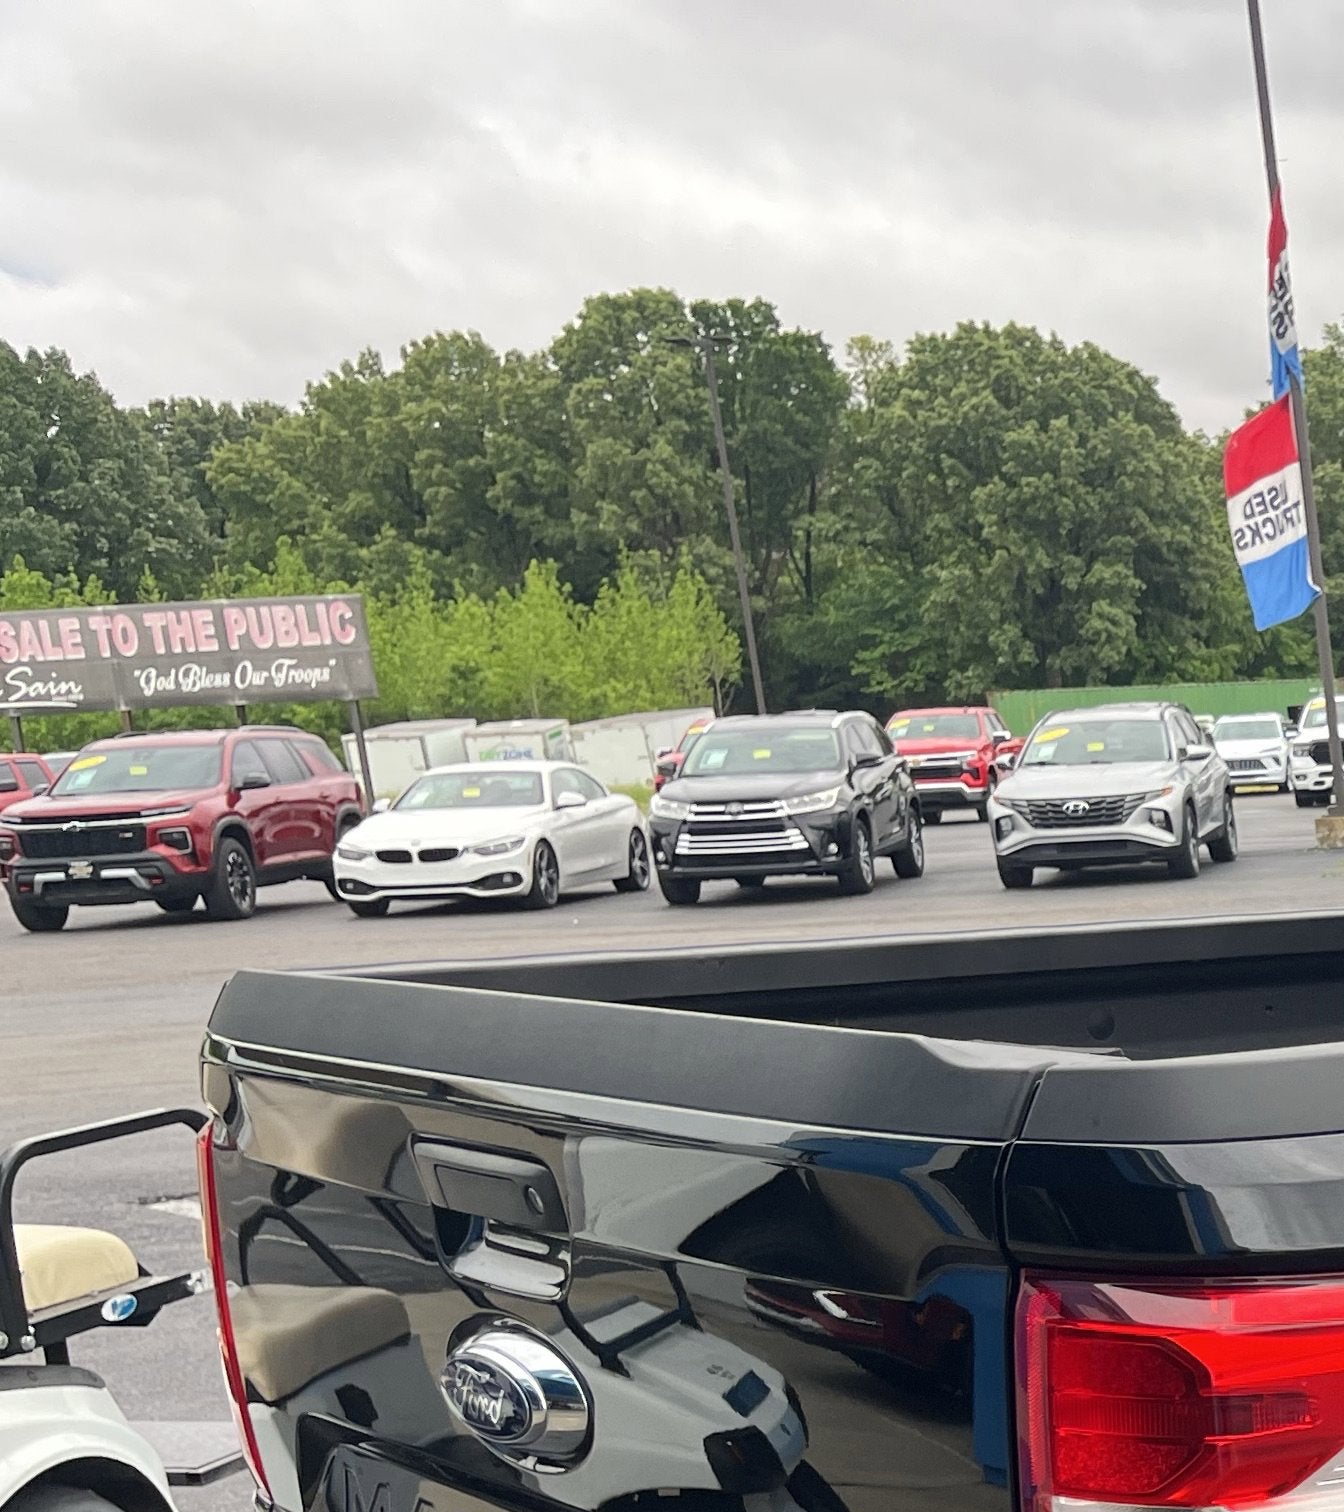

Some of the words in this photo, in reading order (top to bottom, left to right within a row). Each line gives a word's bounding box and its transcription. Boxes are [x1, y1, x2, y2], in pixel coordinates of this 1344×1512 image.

[0, 617, 86, 664] SALE
[88, 613, 139, 658] TO
[143, 607, 219, 655] THE
[223, 600, 356, 650] PUBLIC
[5, 666, 82, 702] Sain
[178, 662, 231, 692] Bless
[235, 660, 268, 689] Our
[453, 1360, 505, 1425] Ford
